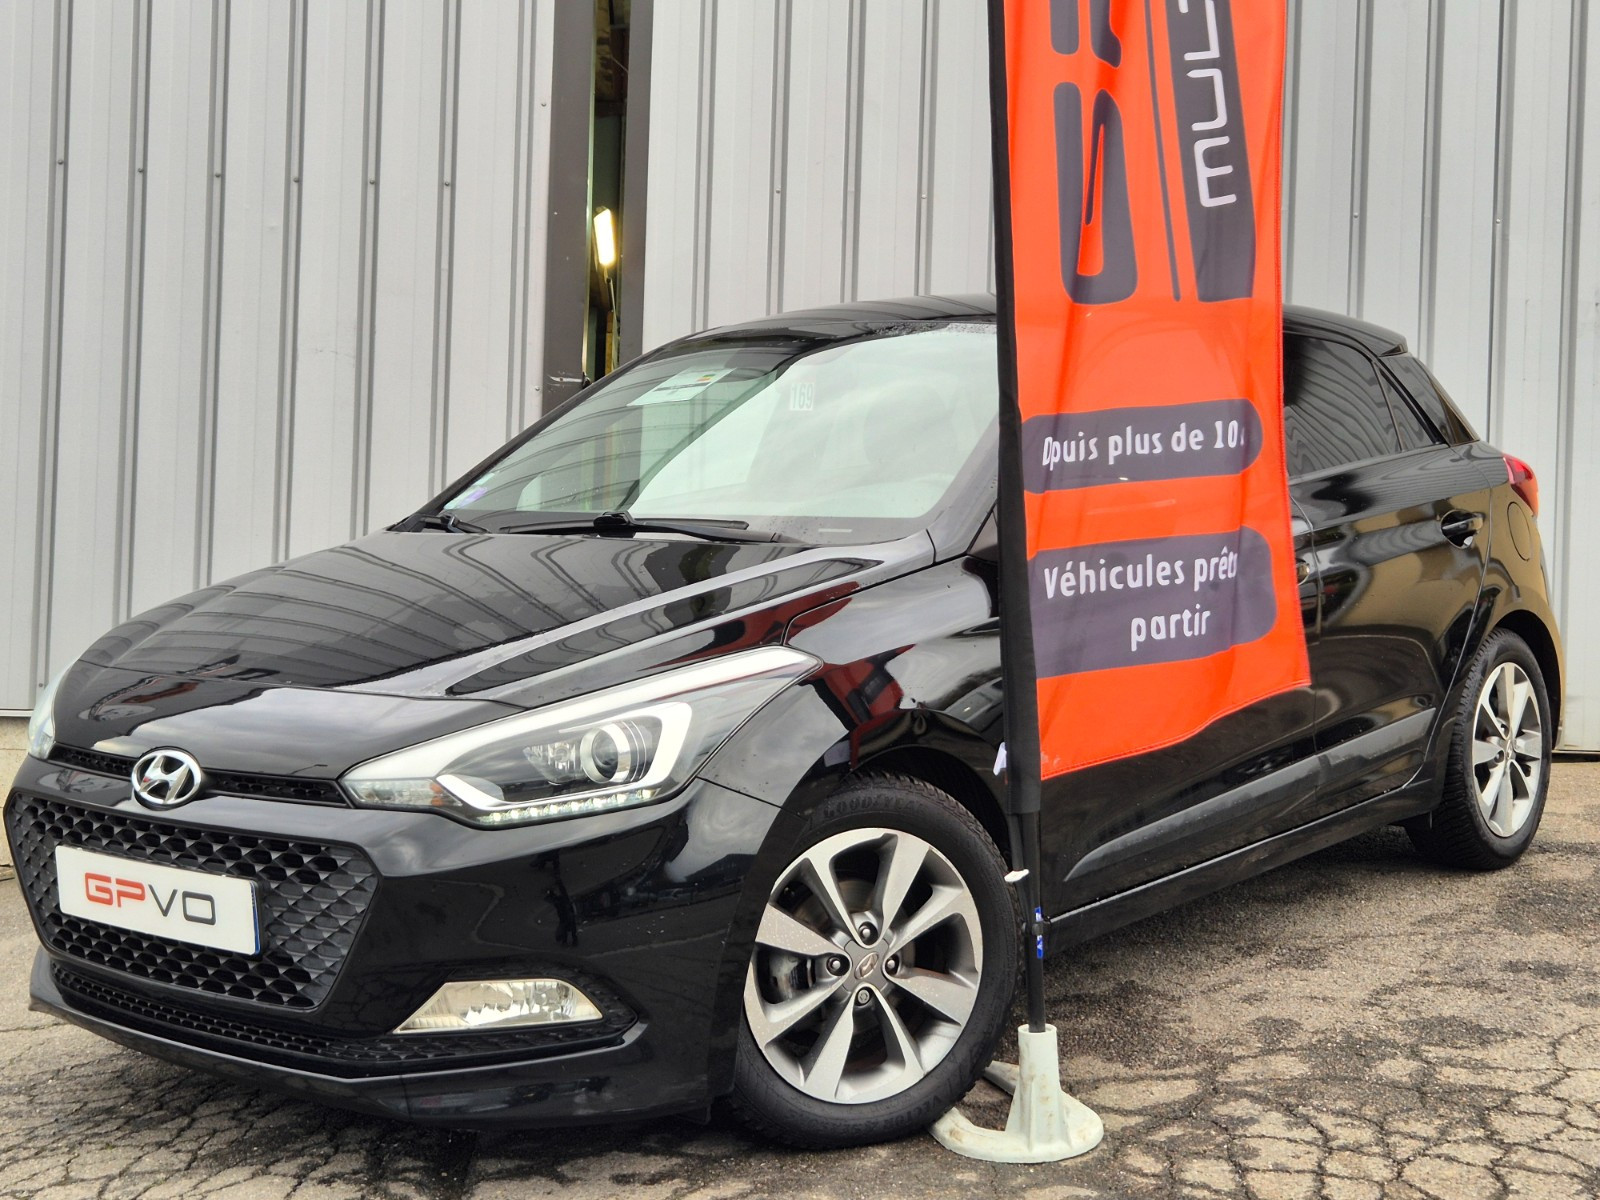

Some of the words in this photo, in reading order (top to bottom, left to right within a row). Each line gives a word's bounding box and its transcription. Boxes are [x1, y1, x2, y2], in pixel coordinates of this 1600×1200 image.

[791, 383, 814, 409] 169
[1108, 425, 1162, 465] plus
[1171, 422, 1204, 451] de
[1044, 553, 1185, 599] Véhicules
[1130, 603, 1211, 652] partir
[84, 872, 217, 926] GPVO
